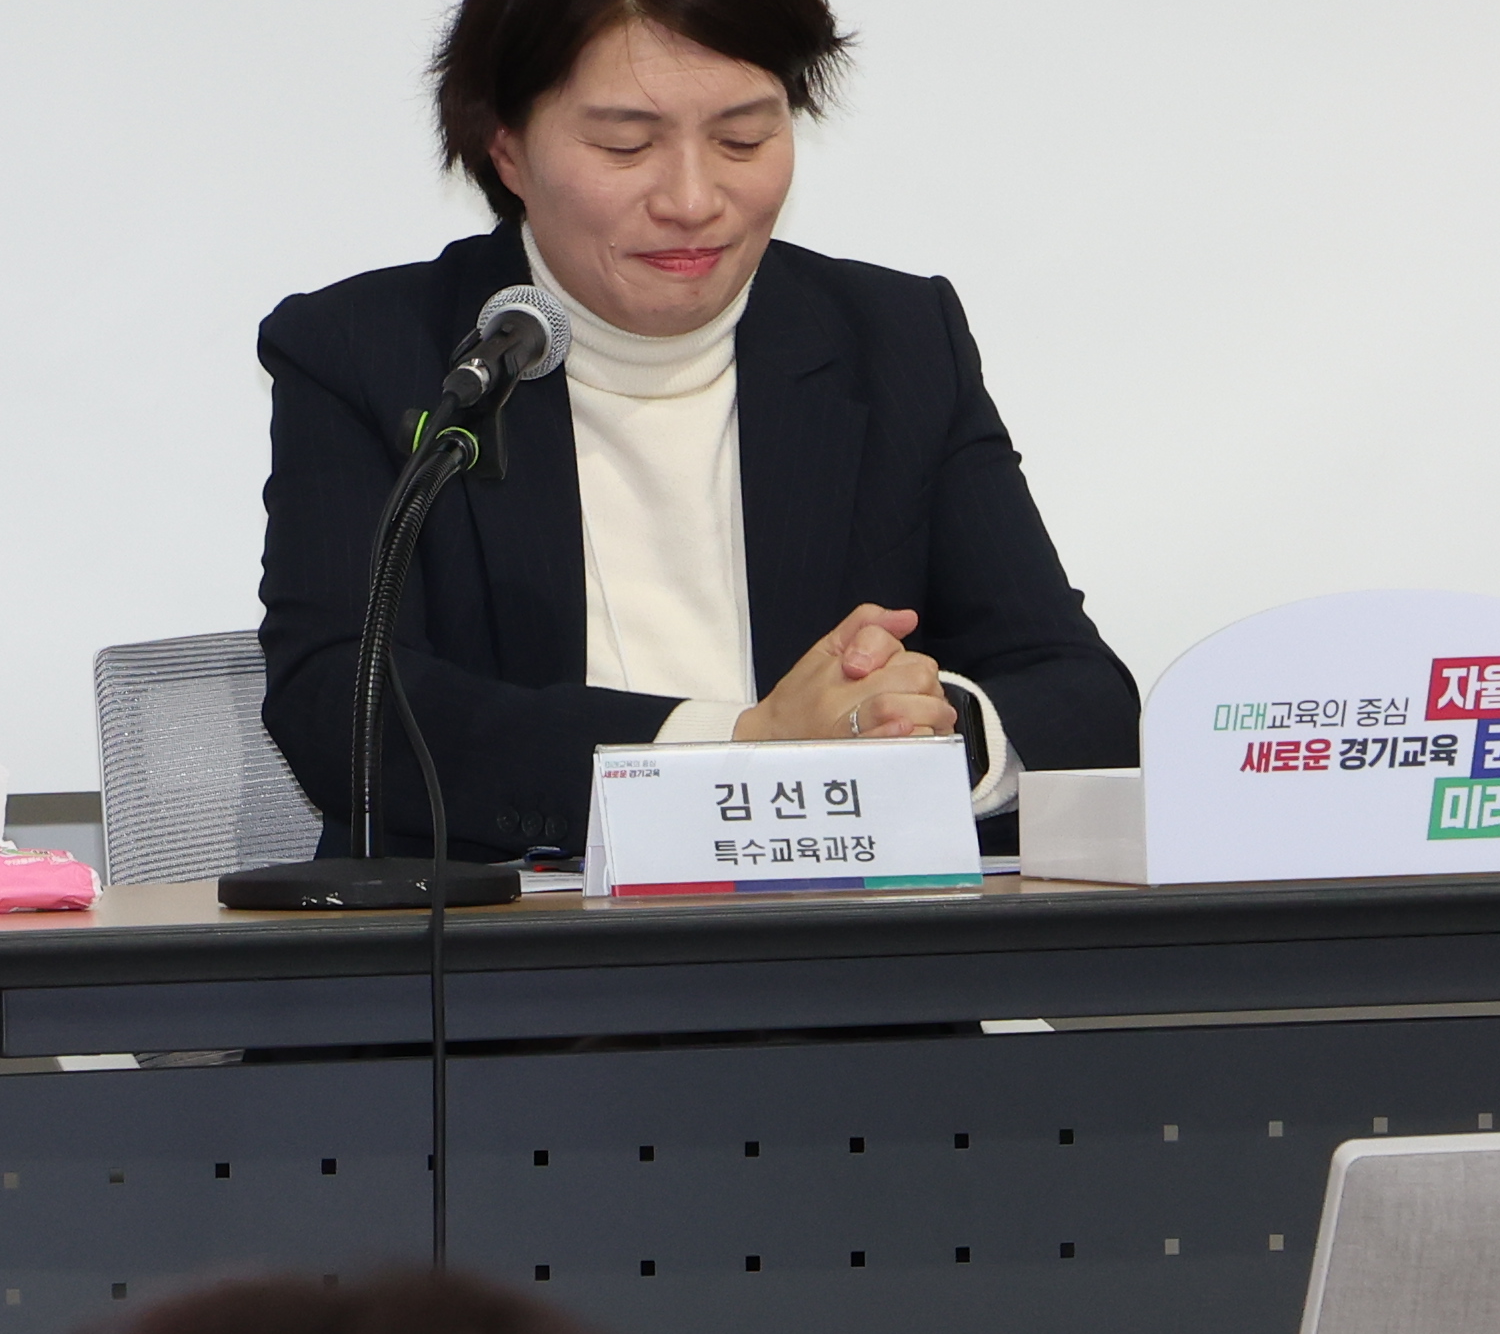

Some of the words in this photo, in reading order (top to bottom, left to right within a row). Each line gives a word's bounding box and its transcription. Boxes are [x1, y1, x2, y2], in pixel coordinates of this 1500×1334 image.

[1213, 699, 1348, 731] 미래교육의
[1356, 697, 1410, 728] 중심
[1239, 738, 1332, 774] 새로운
[1338, 733, 1459, 771] 경기교육
[713, 835, 876, 866] 특수교육과장
